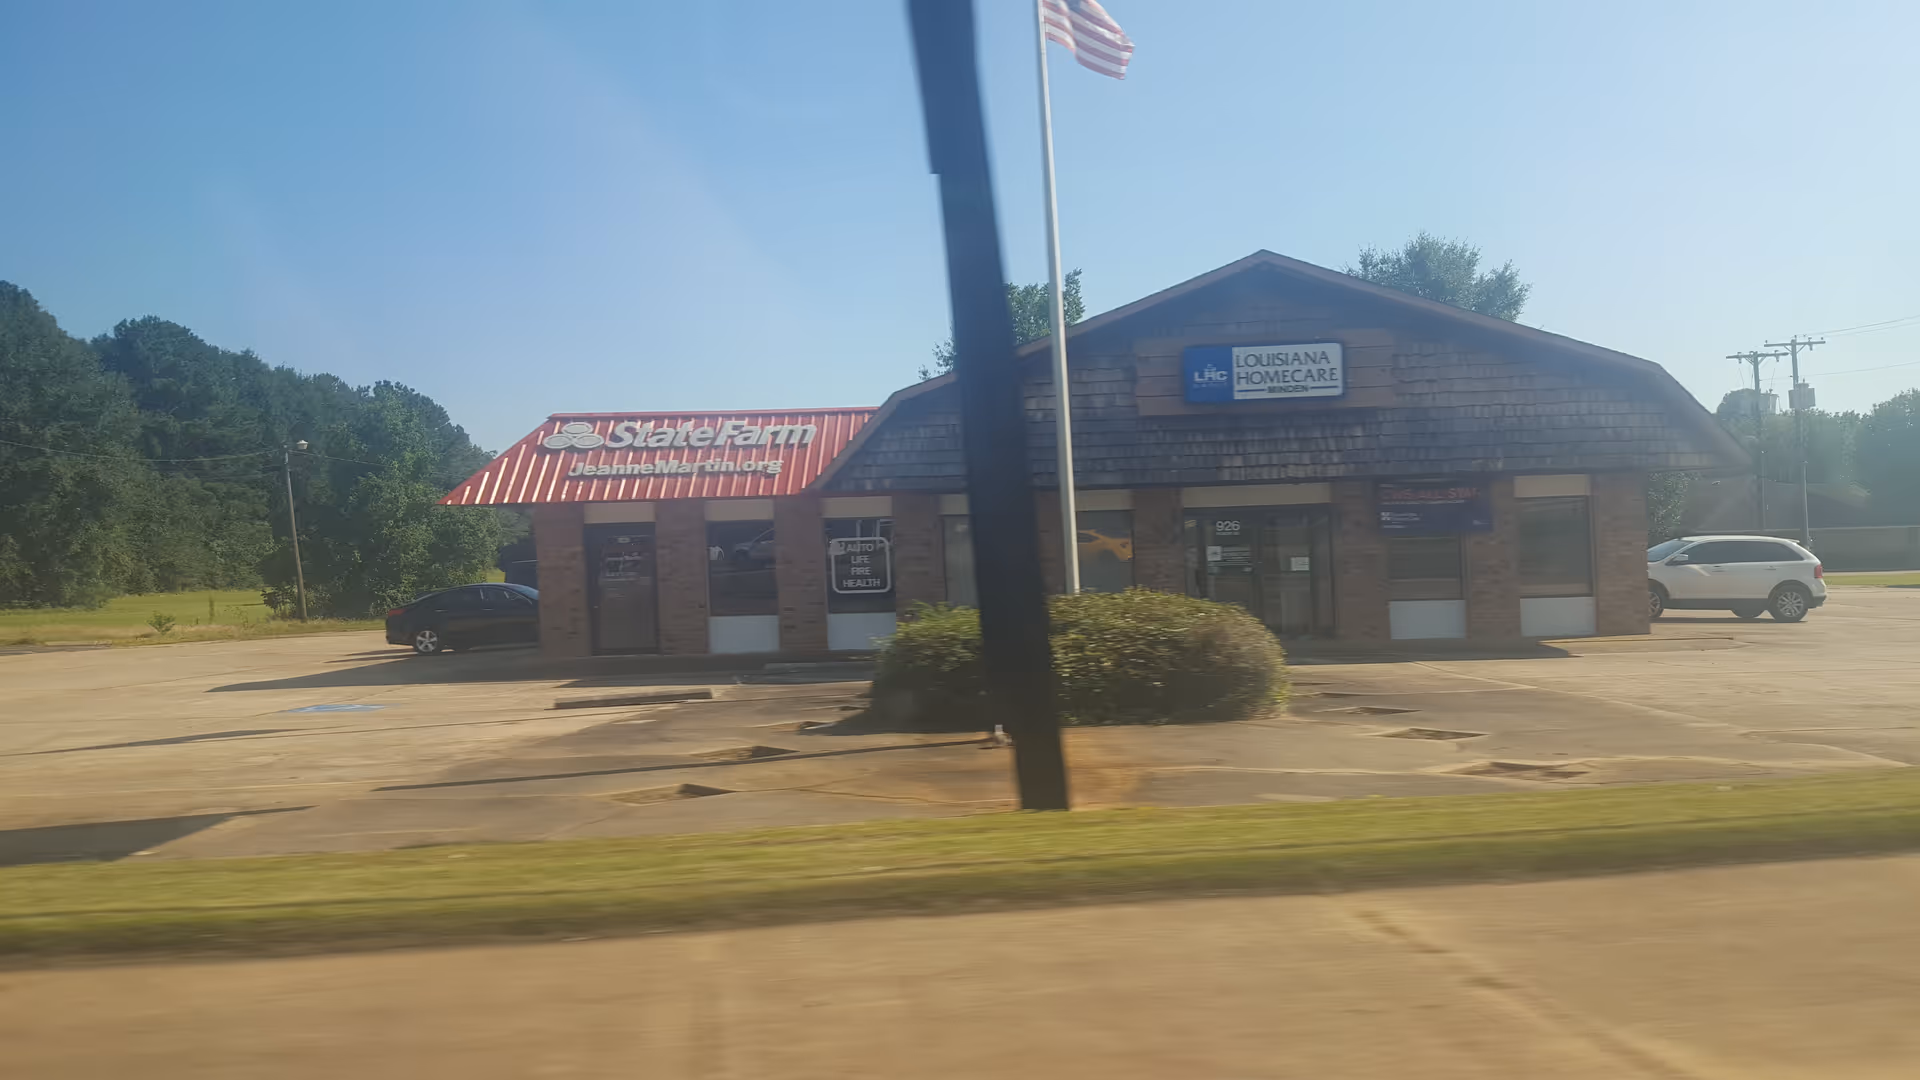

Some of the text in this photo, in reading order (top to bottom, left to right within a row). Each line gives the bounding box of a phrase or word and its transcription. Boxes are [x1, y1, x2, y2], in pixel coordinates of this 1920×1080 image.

[1235, 350, 1331, 368] LOUISIANA
[1193, 368, 1229, 382] LHC
[1236, 368, 1339, 385] HOMECARE
[1266, 385, 1310, 393] MINDEN
[567, 458, 784, 477] JeanneMartin.org
[1216, 520, 1240, 531] 926
[846, 543, 874, 551] AUTO
[851, 555, 871, 563] LIFE
[851, 567, 872, 575] FIRE
[843, 579, 880, 587] HEALTH
